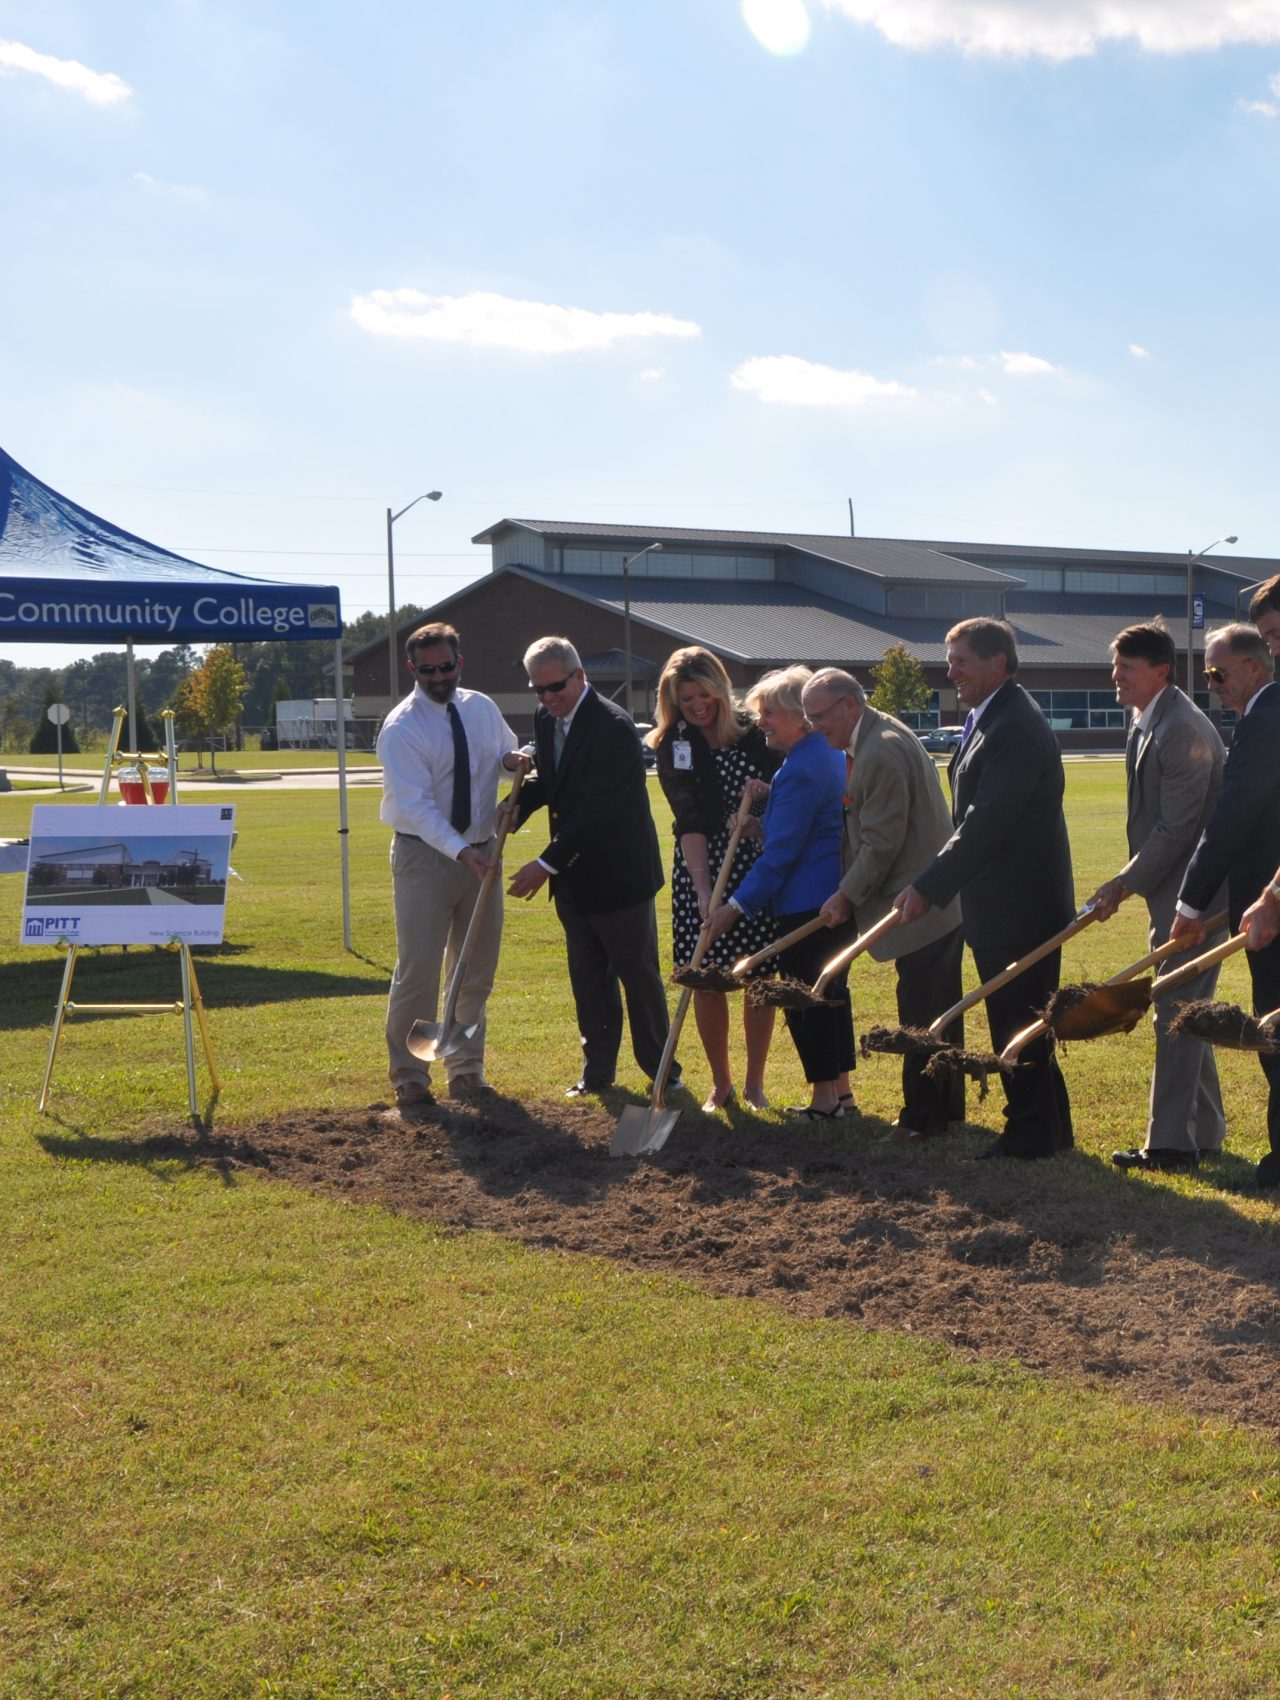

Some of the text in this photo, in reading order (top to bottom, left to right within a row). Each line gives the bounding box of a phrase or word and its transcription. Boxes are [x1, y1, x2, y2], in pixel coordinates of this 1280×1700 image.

[0, 593, 182, 632] Community
[193, 597, 305, 632] College
[45, 917, 80, 929] PITT
[194, 930, 219, 938] Building
